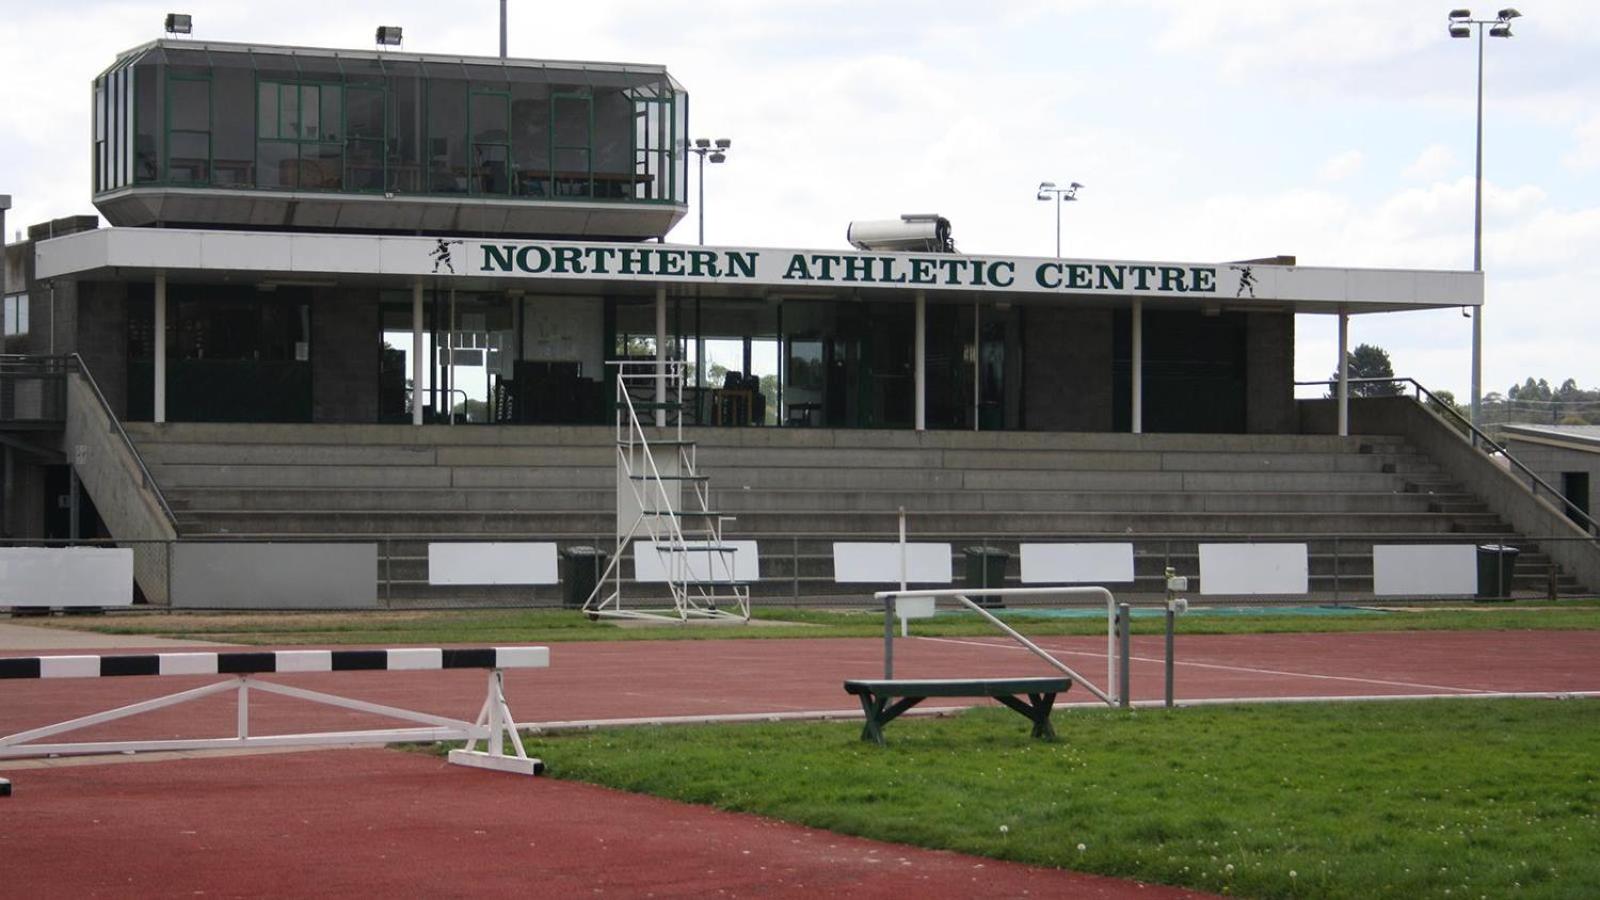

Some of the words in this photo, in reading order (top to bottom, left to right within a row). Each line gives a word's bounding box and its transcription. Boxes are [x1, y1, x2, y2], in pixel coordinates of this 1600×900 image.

[479, 244, 760, 278] NORTHERN
[782, 254, 1015, 288] ATHLETIC
[1035, 262, 1216, 293] CENTRE
